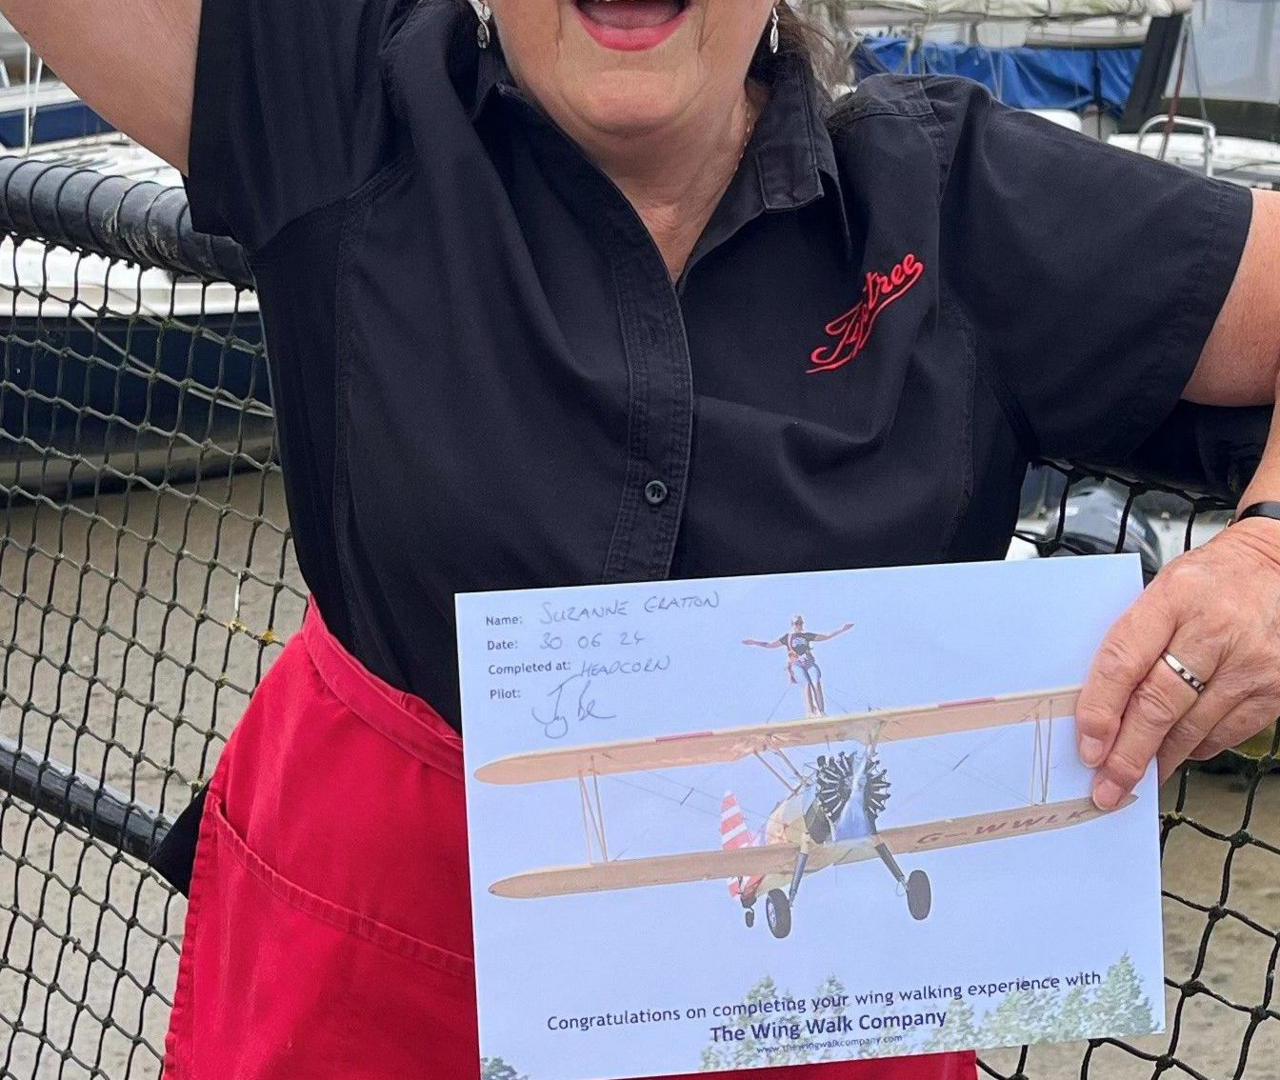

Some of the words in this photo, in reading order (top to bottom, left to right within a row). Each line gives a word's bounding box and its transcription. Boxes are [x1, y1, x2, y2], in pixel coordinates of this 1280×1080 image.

[485, 615, 523, 626] Name:
[539, 601, 629, 625] SUZANNE
[487, 639, 519, 651] Date:
[539, 632, 563, 650] 30
[577, 632, 602, 649] 06
[488, 661, 552, 675] Completed
[555, 661, 571, 672] at:
[489, 688, 521, 700] Pilot:
[547, 1009, 681, 1031] Congratulations
[686, 1006, 707, 1020] on
[712, 998, 806, 1018] completing
[810, 994, 849, 1013] your
[854, 990, 894, 1007] wing
[898, 984, 963, 1001] walking
[967, 976, 1060, 997] experience
[1065, 970, 1102, 987] with
[709, 1025, 746, 1043] The
[750, 1020, 801, 1040] Wing
[805, 1015, 853, 1034] Walk
[858, 1009, 949, 1032] Company
